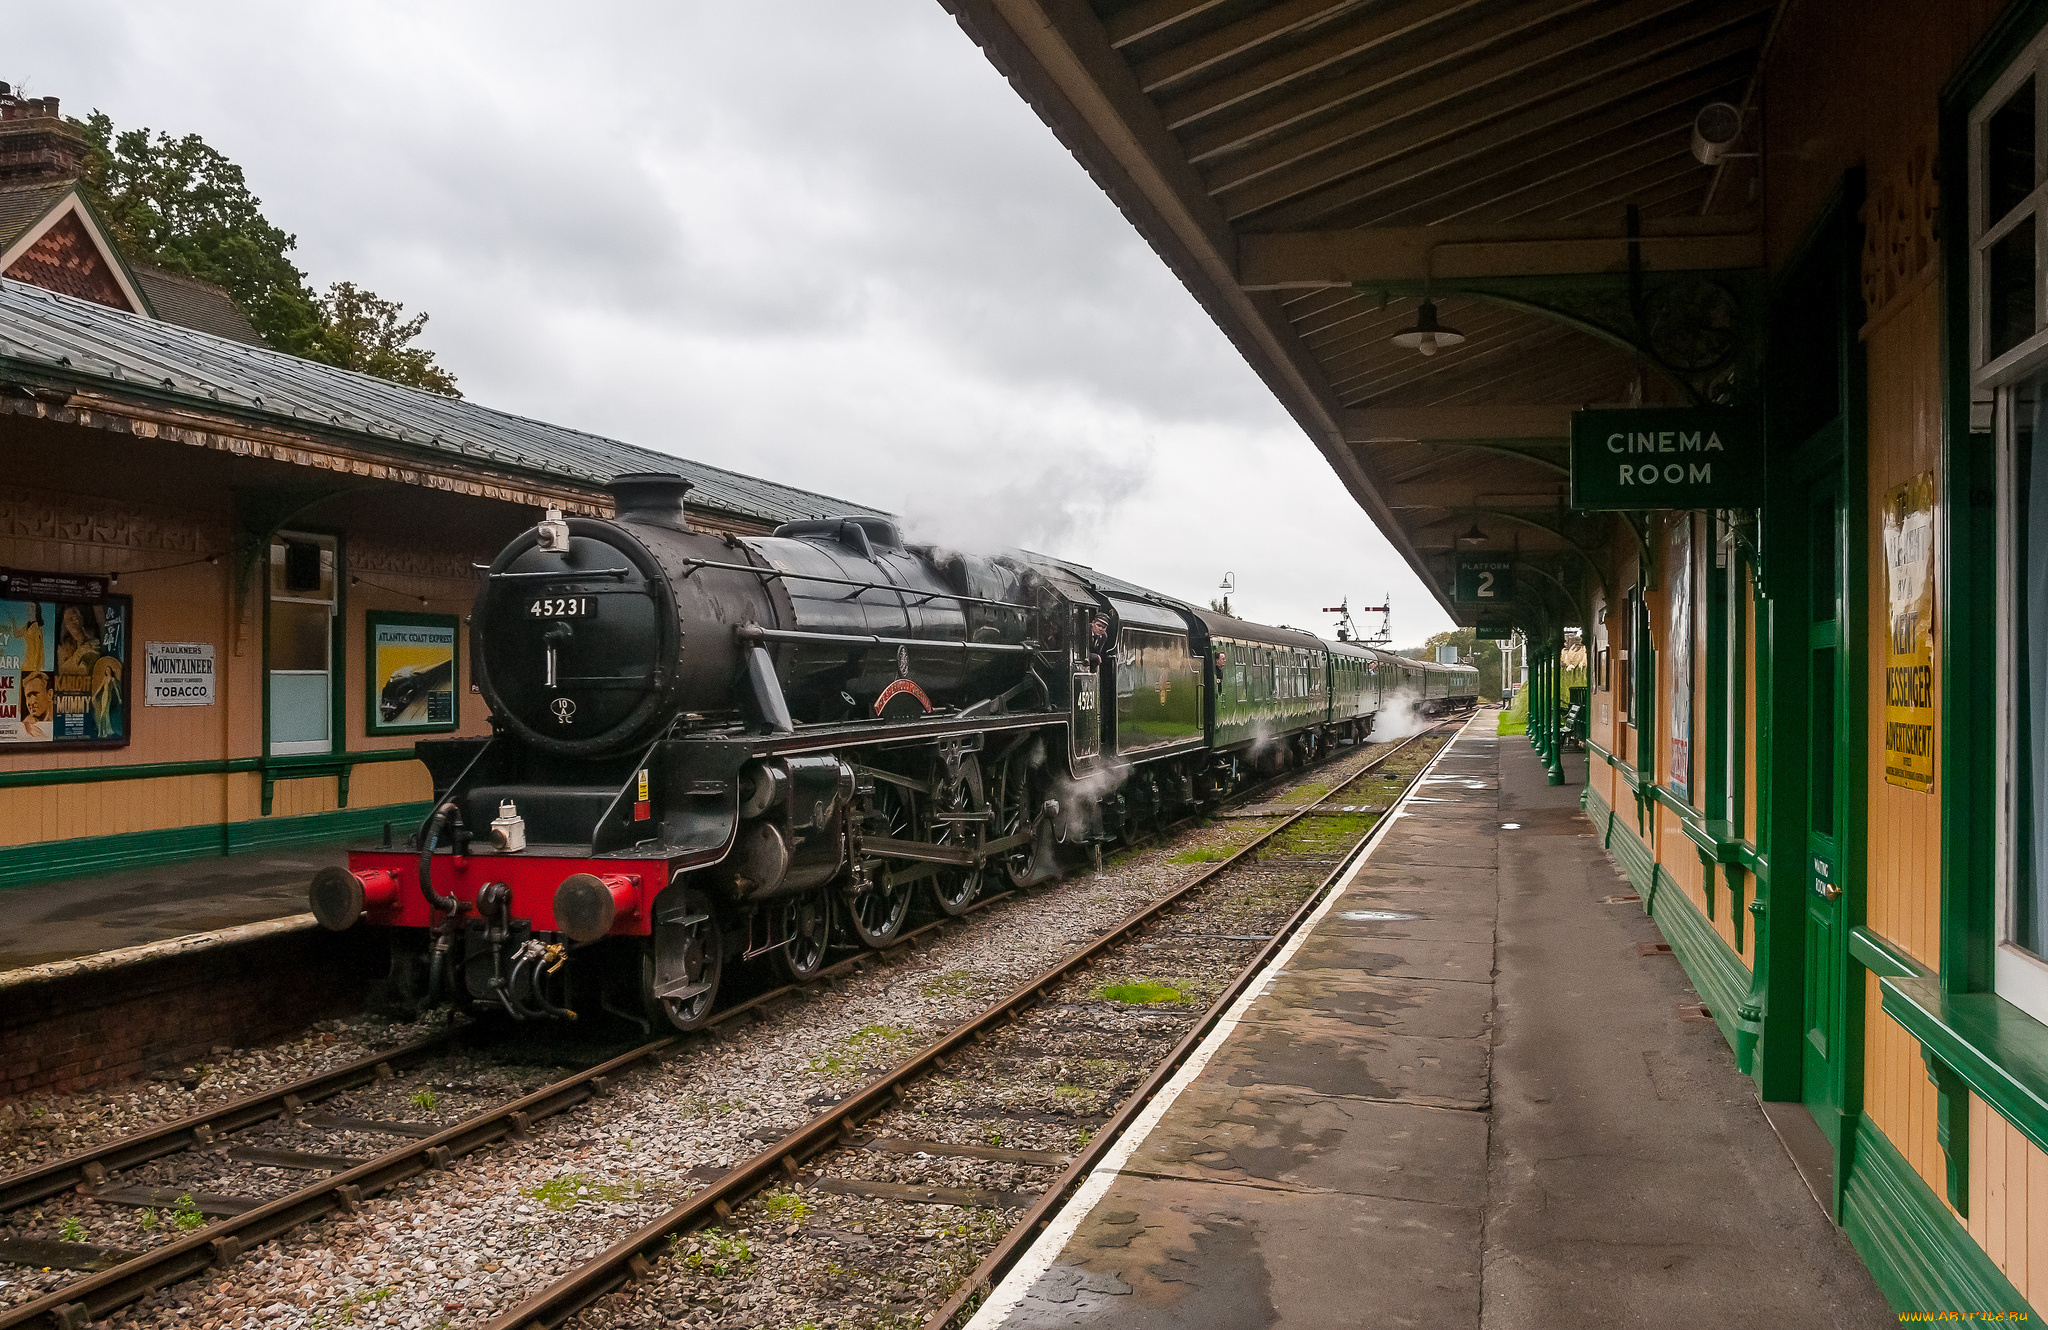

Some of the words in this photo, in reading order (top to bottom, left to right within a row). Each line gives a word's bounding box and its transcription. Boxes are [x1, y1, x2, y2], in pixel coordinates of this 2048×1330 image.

[1607, 431, 1724, 453] CINEMA
[1619, 463, 1711, 485] ROOM
[1903, 524, 1926, 564] KENT
[1477, 571, 1494, 597] 2
[1897, 579, 1907, 600] BY
[1907, 576, 1913, 599] A
[530, 598, 586, 617] 45231
[379, 632, 406, 642] ATLANTIC
[408, 633, 428, 643] COAST
[428, 634, 453, 644] EXPRESS
[1893, 611, 1917, 655] KENT
[161, 646, 202, 655] FAULKNERS
[150, 656, 212, 674] MOUNTAINEER
[154, 686, 207, 697] TOBACCO
[1886, 665, 1932, 708] MESSENGER
[57, 695, 91, 714] MUMMY
[558, 700, 568, 708] 10
[1077, 691, 1095, 711] 45231
[1886, 721, 1932, 758] ADVERTISEMENT
